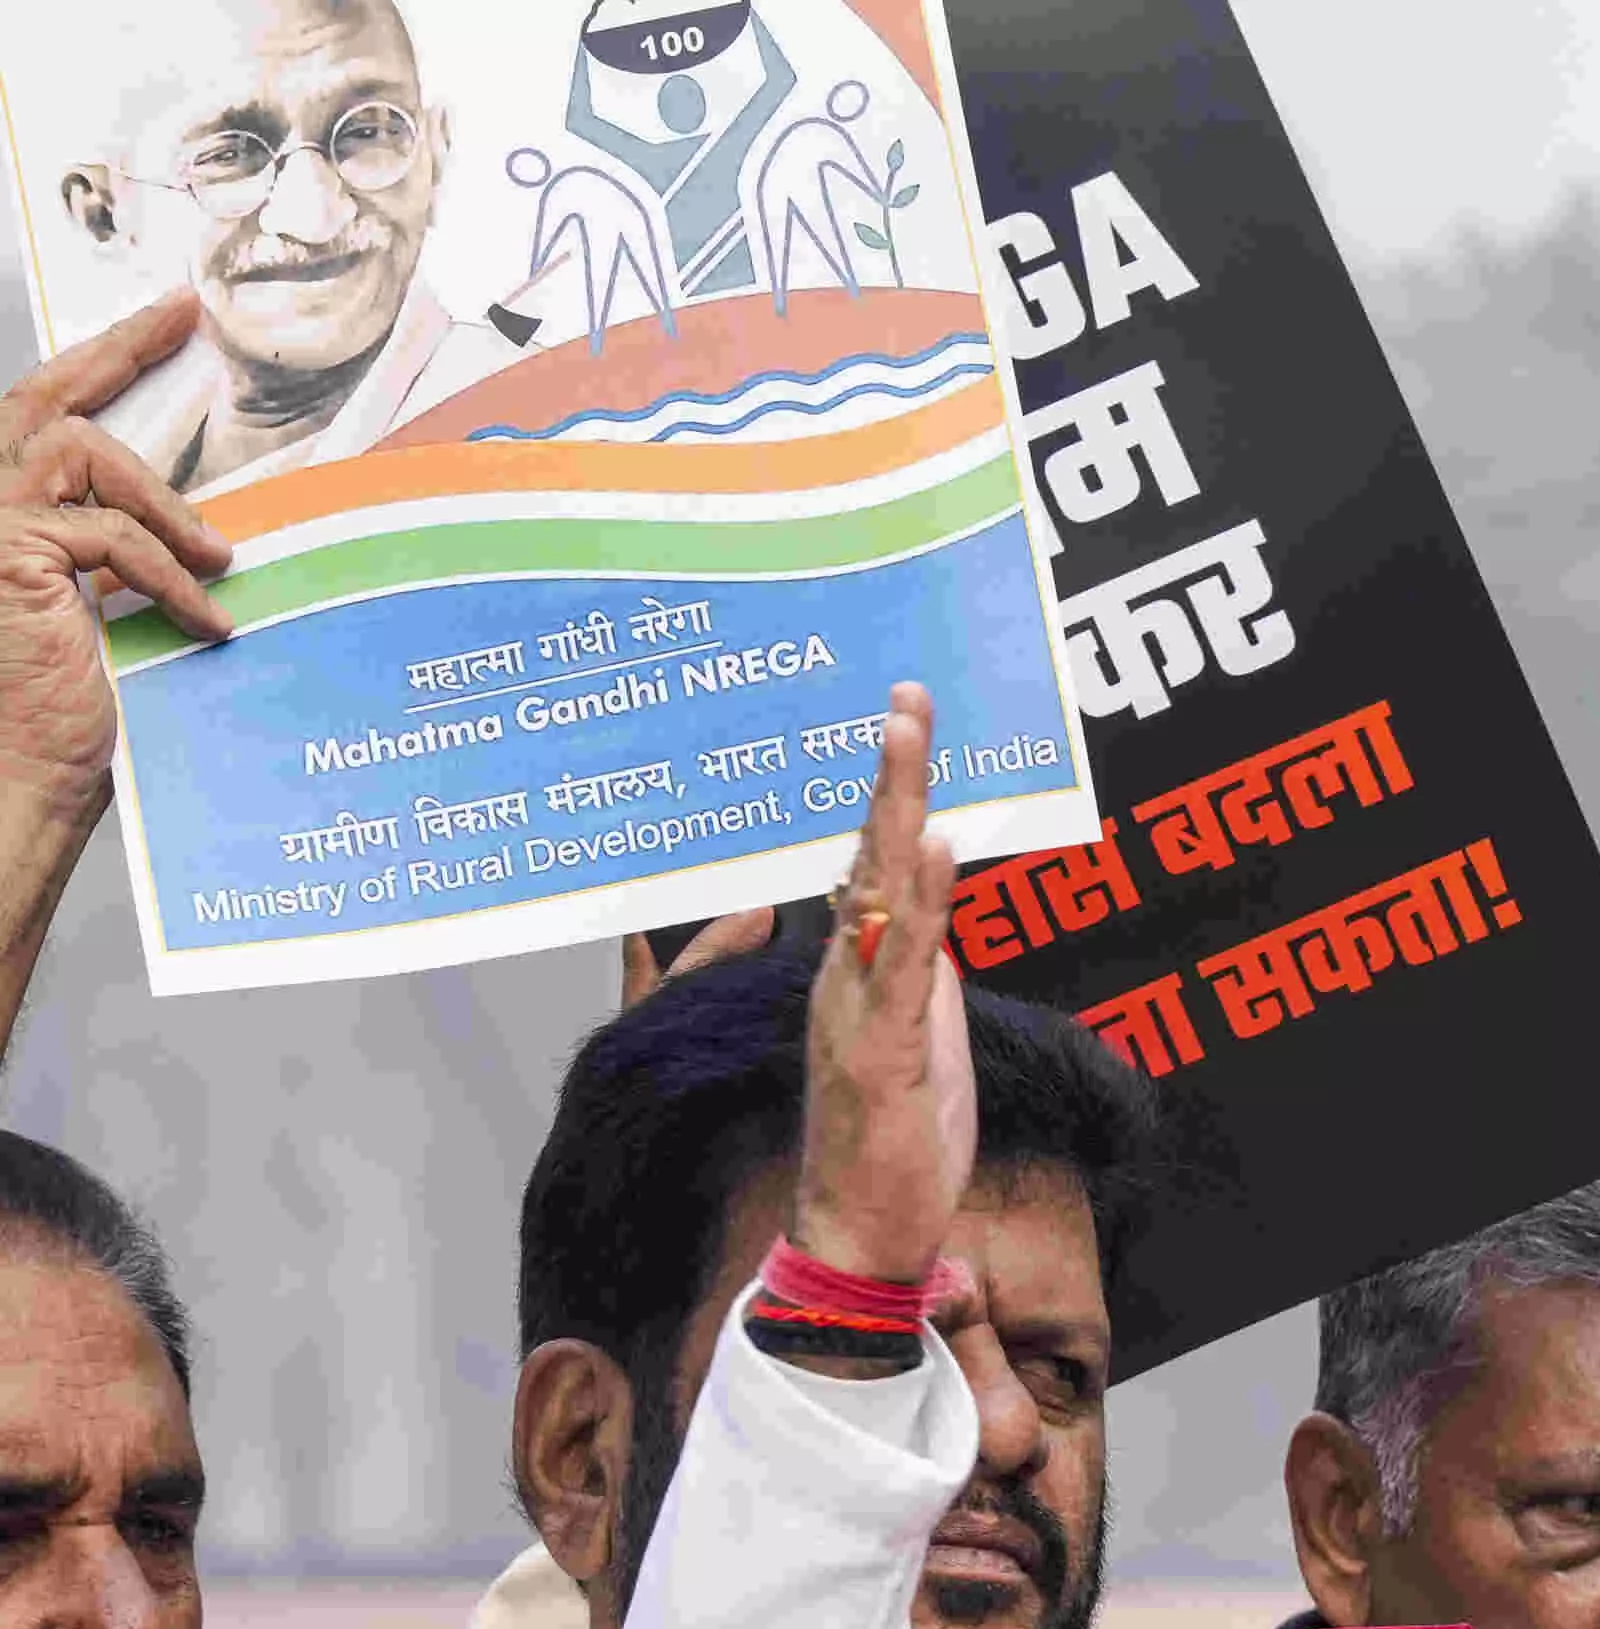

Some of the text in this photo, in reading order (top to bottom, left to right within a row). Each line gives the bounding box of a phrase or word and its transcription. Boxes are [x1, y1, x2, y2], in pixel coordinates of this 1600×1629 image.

[639, 26, 705, 60] 100
[985, 170, 1200, 360] GA
[1022, 359, 1201, 557] म
[304, 634, 835, 776] Mahatma Gandhi NREGA
[407, 597, 712, 691] महात्मा गांधी नरेगा
[191, 880, 346, 923] Ministry
[359, 866, 397, 903] of
[407, 845, 513, 895] Rural
[525, 789, 793, 874] Development,
[803, 773, 879, 812] Gov
[963, 733, 1059, 777] India
[280, 812, 400, 864] ग्रामीण
[412, 796, 528, 845] विकास
[544, 773, 686, 814] मंत्रालय,
[698, 736, 787, 782] भारत
[943, 699, 1415, 979] हास बदला
[1196, 836, 1524, 1040] सकता!
